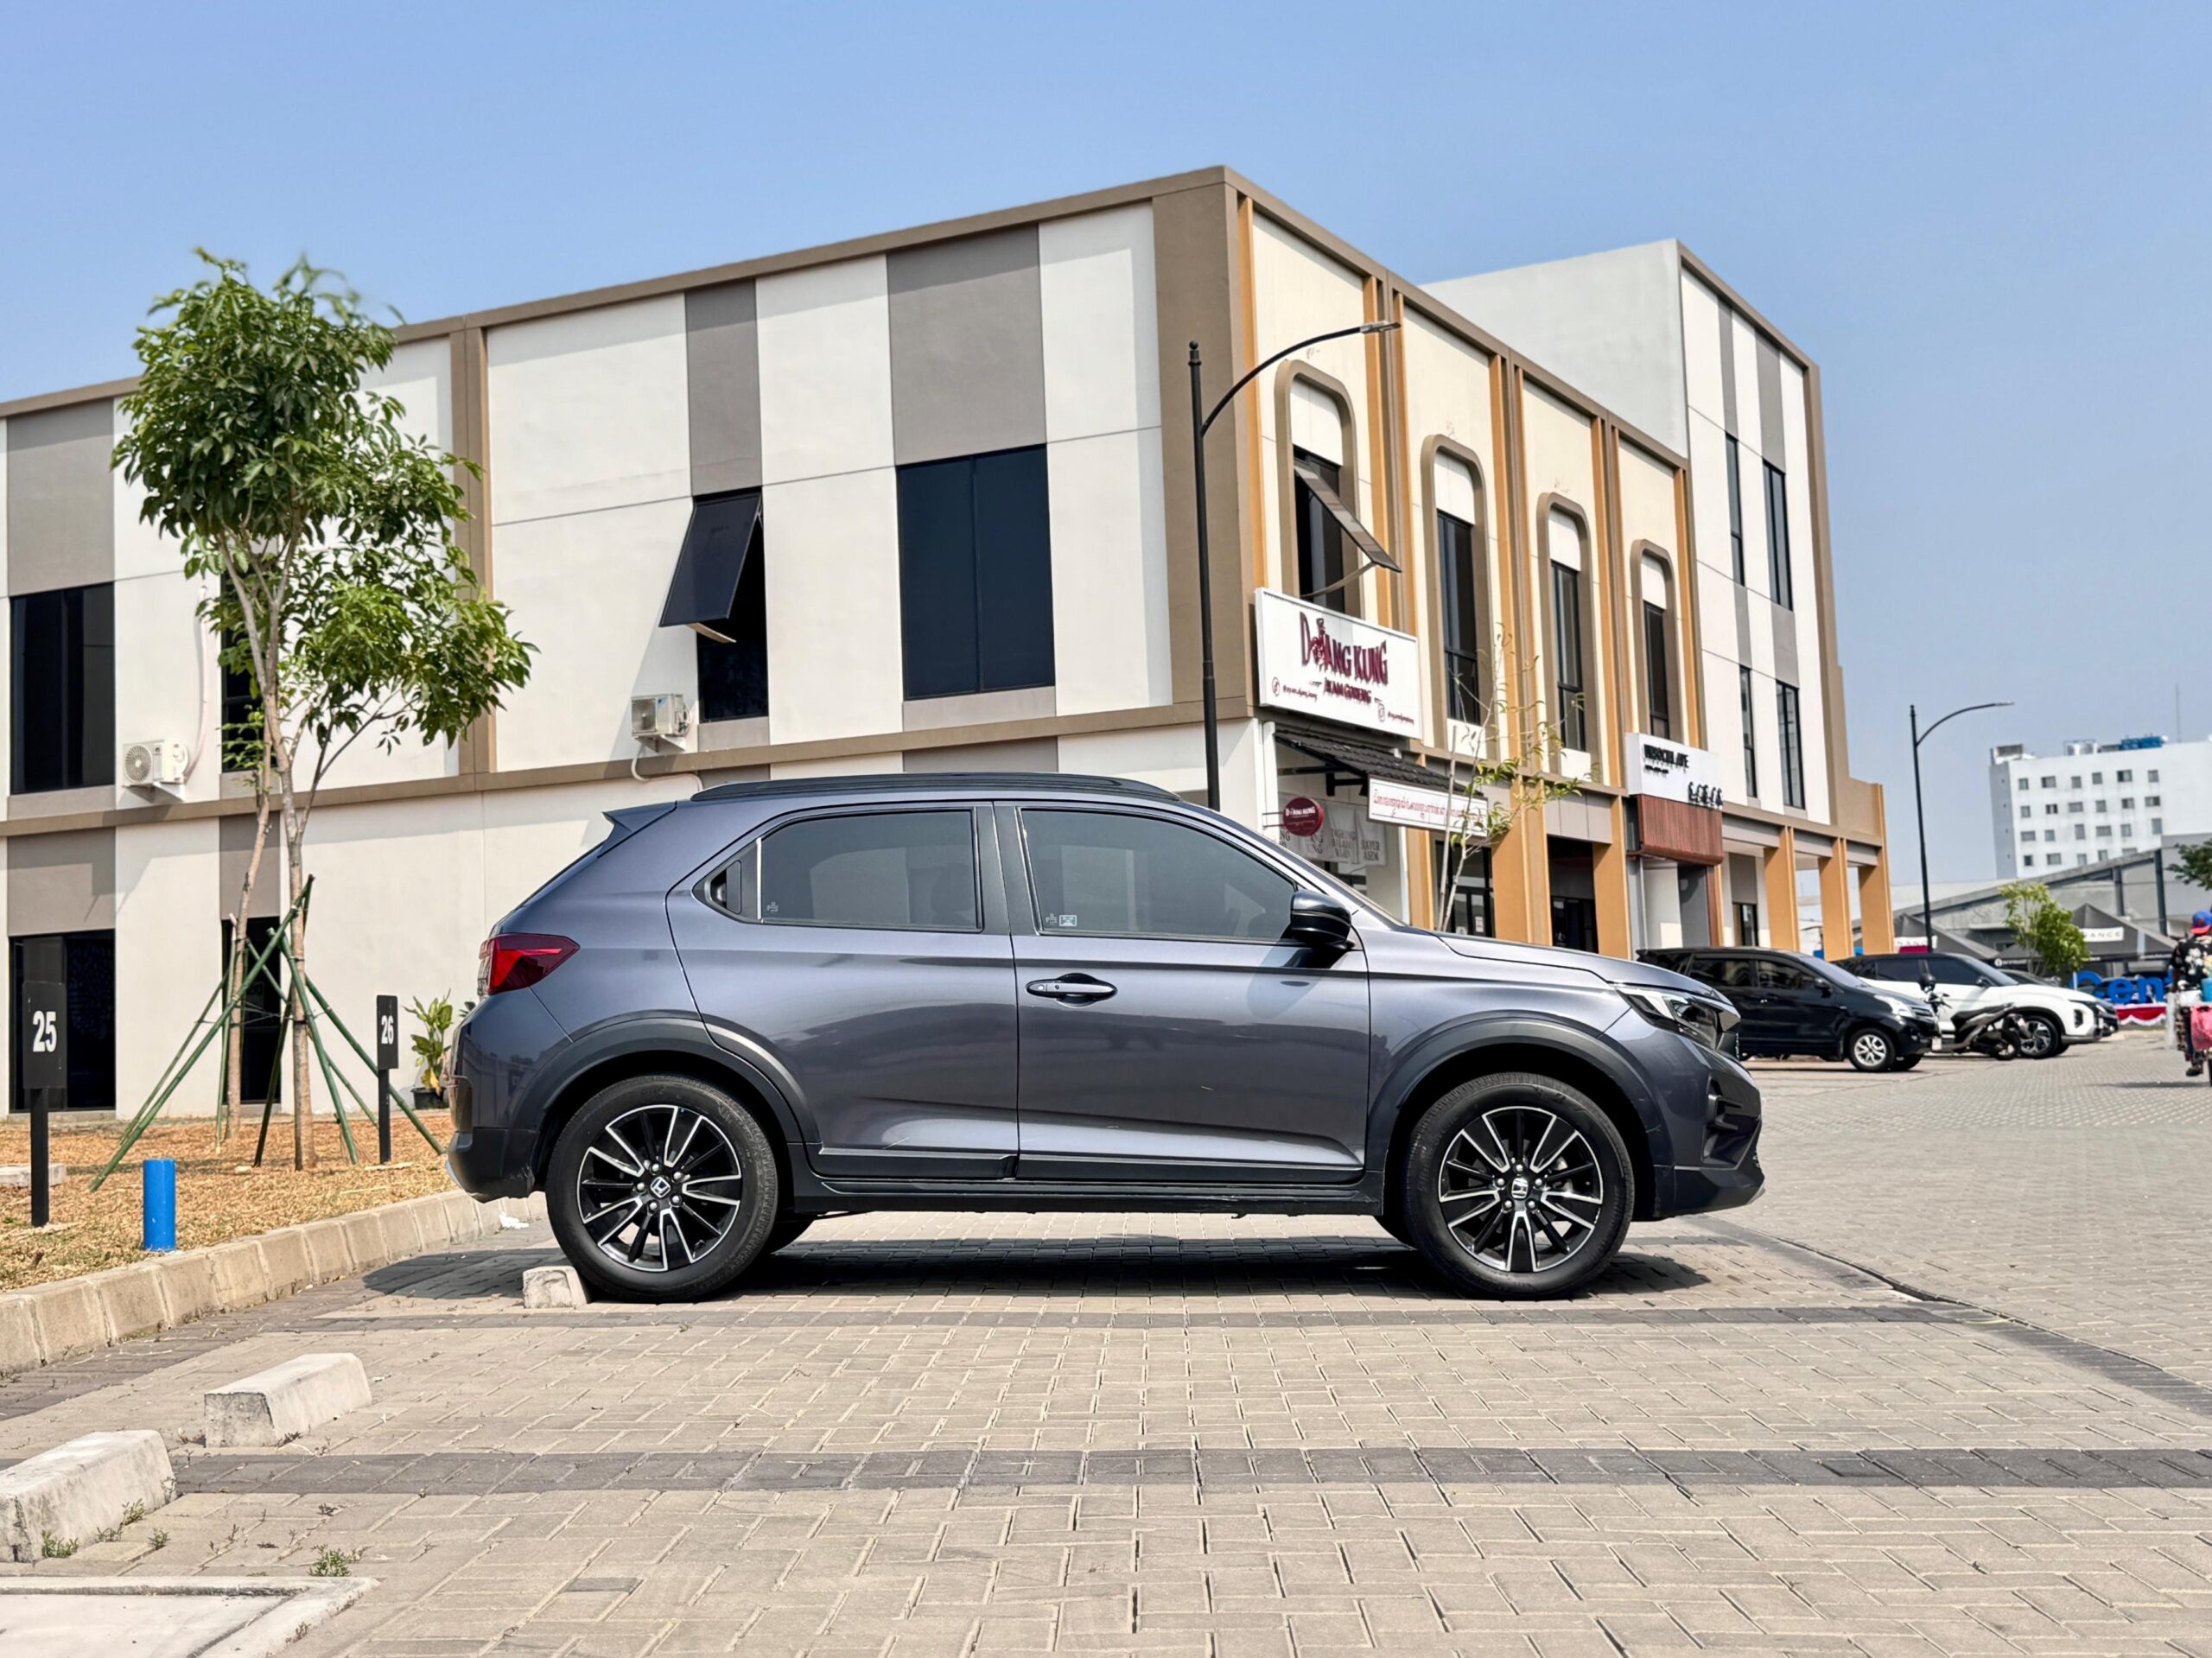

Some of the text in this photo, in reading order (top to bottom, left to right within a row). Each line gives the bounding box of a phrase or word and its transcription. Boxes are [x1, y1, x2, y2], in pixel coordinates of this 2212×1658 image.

[1353, 640, 1388, 686] KUNG
[33, 1010, 57, 1052] 25
[381, 1014, 394, 1045] 26
